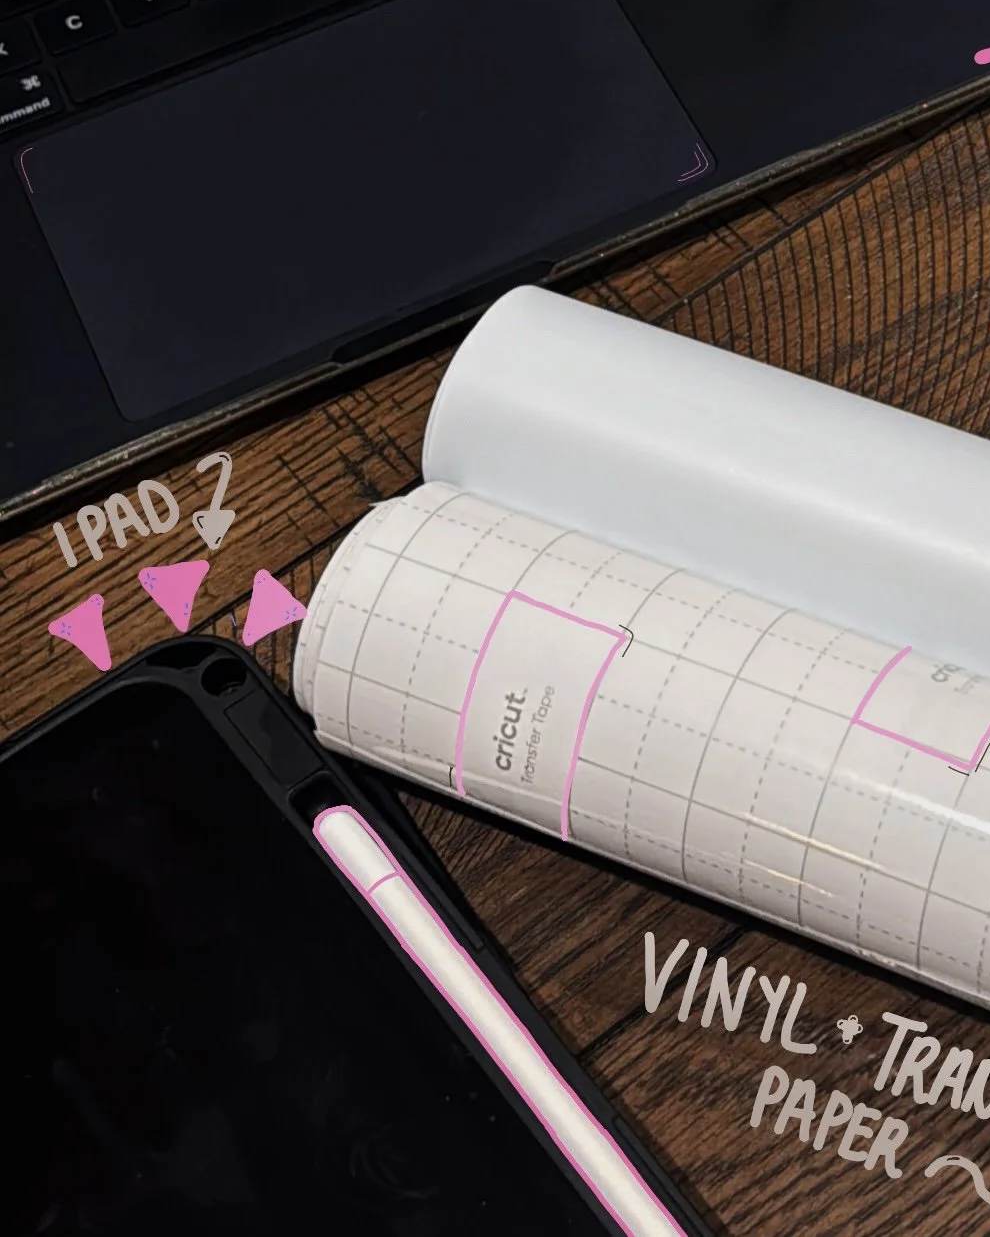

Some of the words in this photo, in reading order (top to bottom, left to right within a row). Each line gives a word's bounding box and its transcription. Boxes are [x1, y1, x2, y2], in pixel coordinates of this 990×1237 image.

[65, 15, 83, 31] C
[0, 97, 51, 124] mmand
[495, 688, 529, 772] cricut
[520, 728, 542, 785] Transfer
[531, 685, 556, 724] Tape
